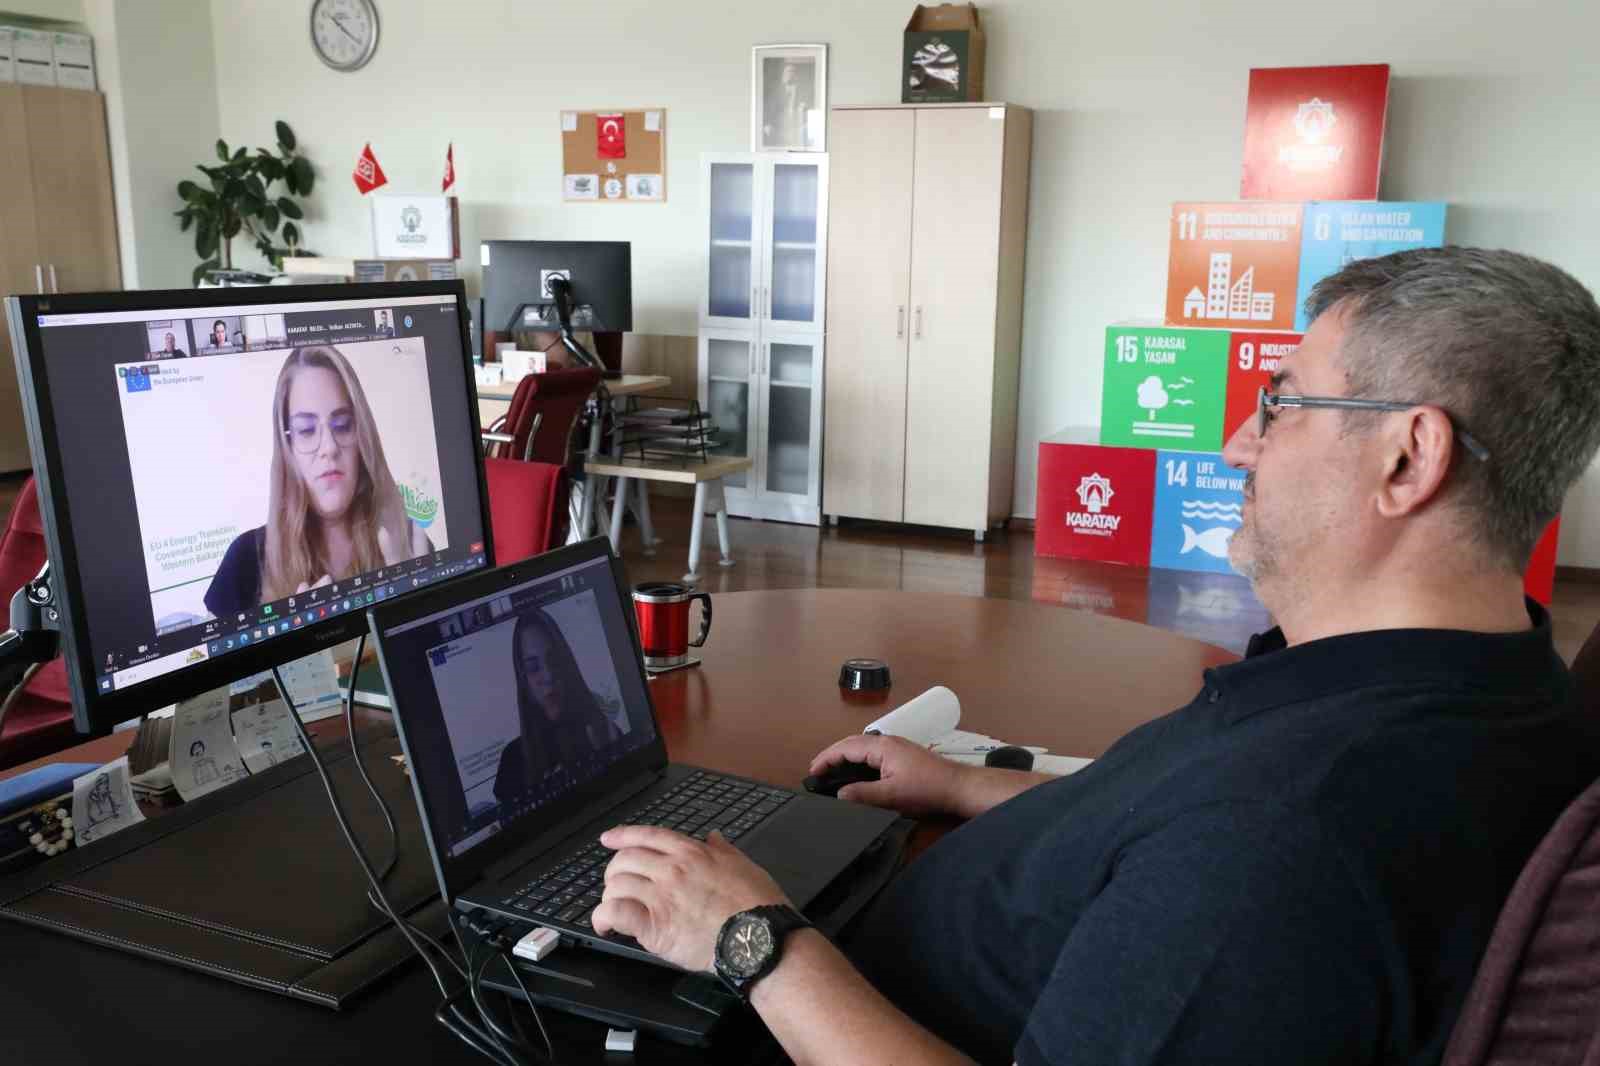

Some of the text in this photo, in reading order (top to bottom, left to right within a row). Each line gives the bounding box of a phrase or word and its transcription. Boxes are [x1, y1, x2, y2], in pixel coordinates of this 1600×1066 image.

[1178, 212, 1197, 240] 11
[1314, 212, 1331, 241] 6
[1115, 335, 1138, 363] 15
[1144, 336, 1186, 350] KARASAL
[1238, 342, 1255, 371] 9
[1165, 459, 1189, 487] 14
[1197, 462, 1216, 475] LIFE
[1196, 476, 1229, 490] BELOW
[1066, 511, 1121, 531] KARATAY
